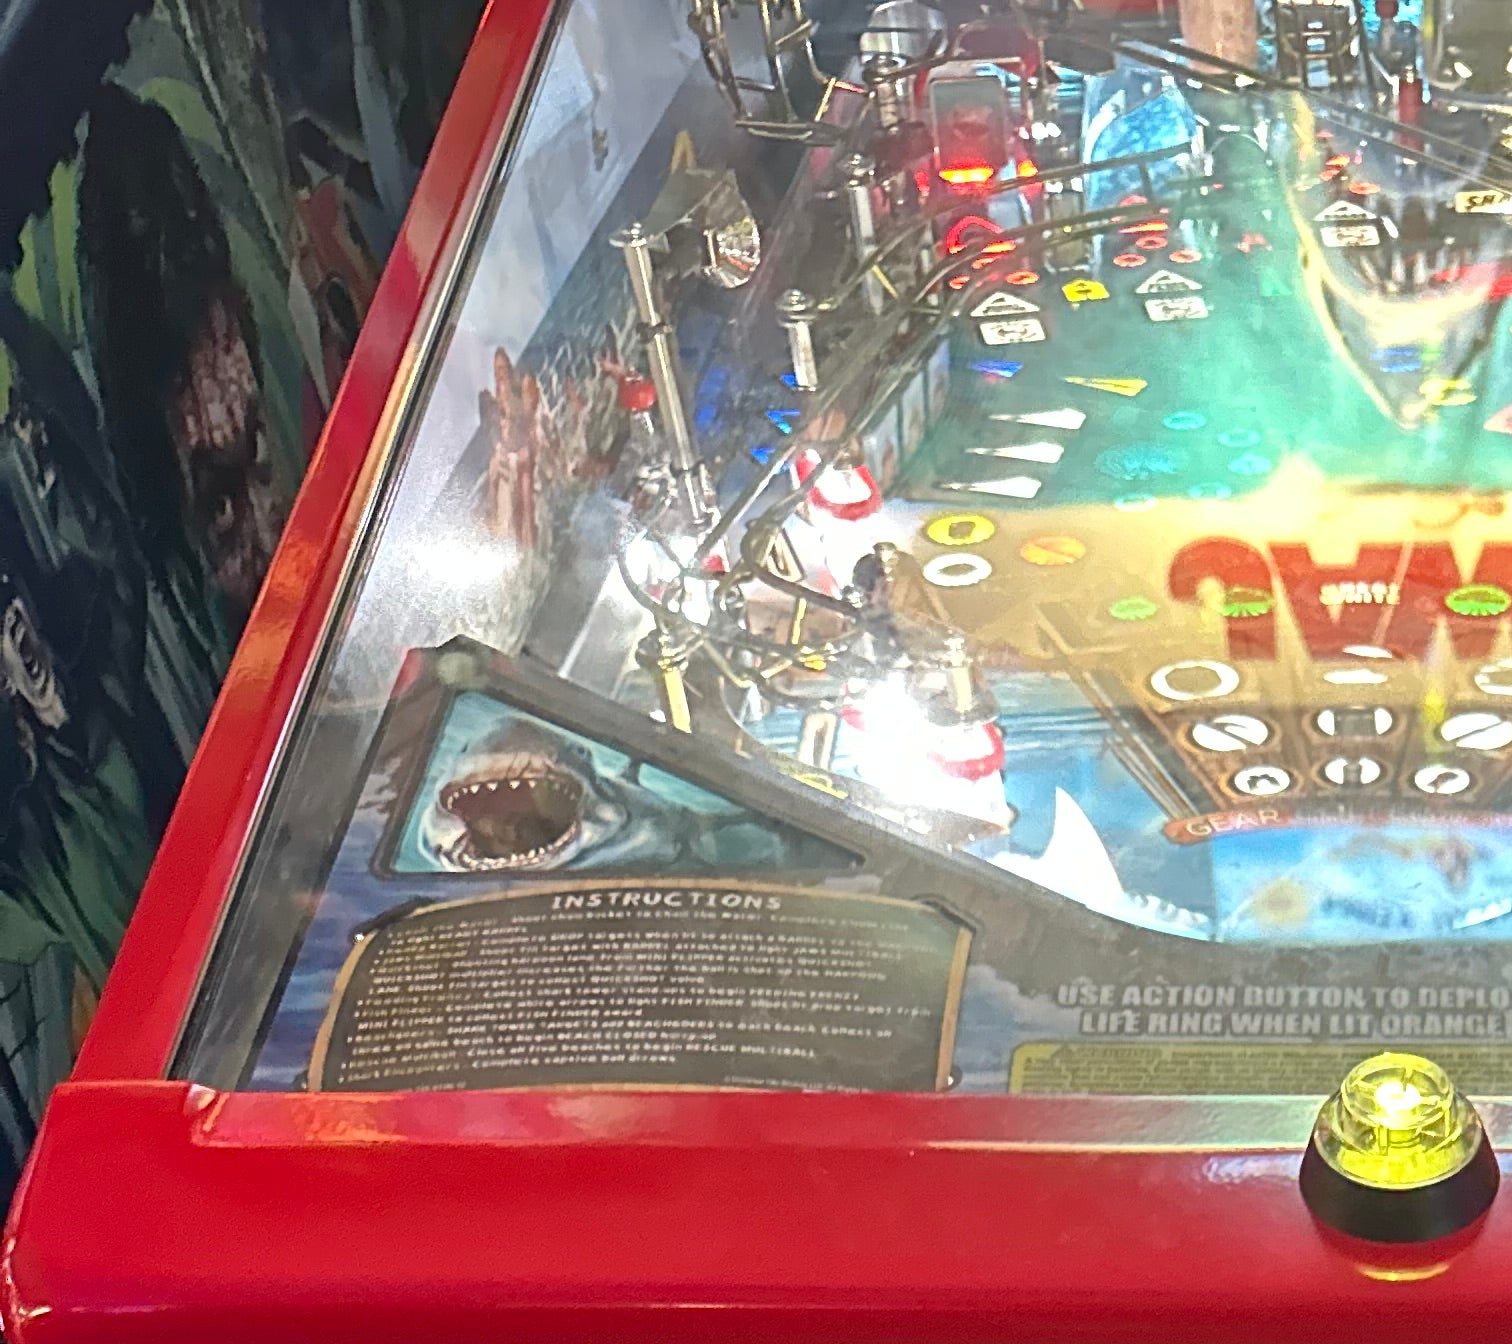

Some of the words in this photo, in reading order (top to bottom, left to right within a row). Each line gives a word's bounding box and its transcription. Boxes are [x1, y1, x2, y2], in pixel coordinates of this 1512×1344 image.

[1187, 808, 1281, 836] GEAR
[551, 892, 782, 911] INSTRUCTIONS
[1057, 985, 1116, 1009] USE
[1122, 985, 1237, 1010] ACTION
[1246, 985, 1366, 1010] BUTTON
[1374, 985, 1412, 1009] TO
[1081, 1011, 1140, 1035] LIFE
[1148, 1011, 1223, 1035] RING
[1230, 1011, 1321, 1035] WHEN
[1329, 1011, 1374, 1035] LIT
[1382, 1011, 1506, 1035] ORANGE
